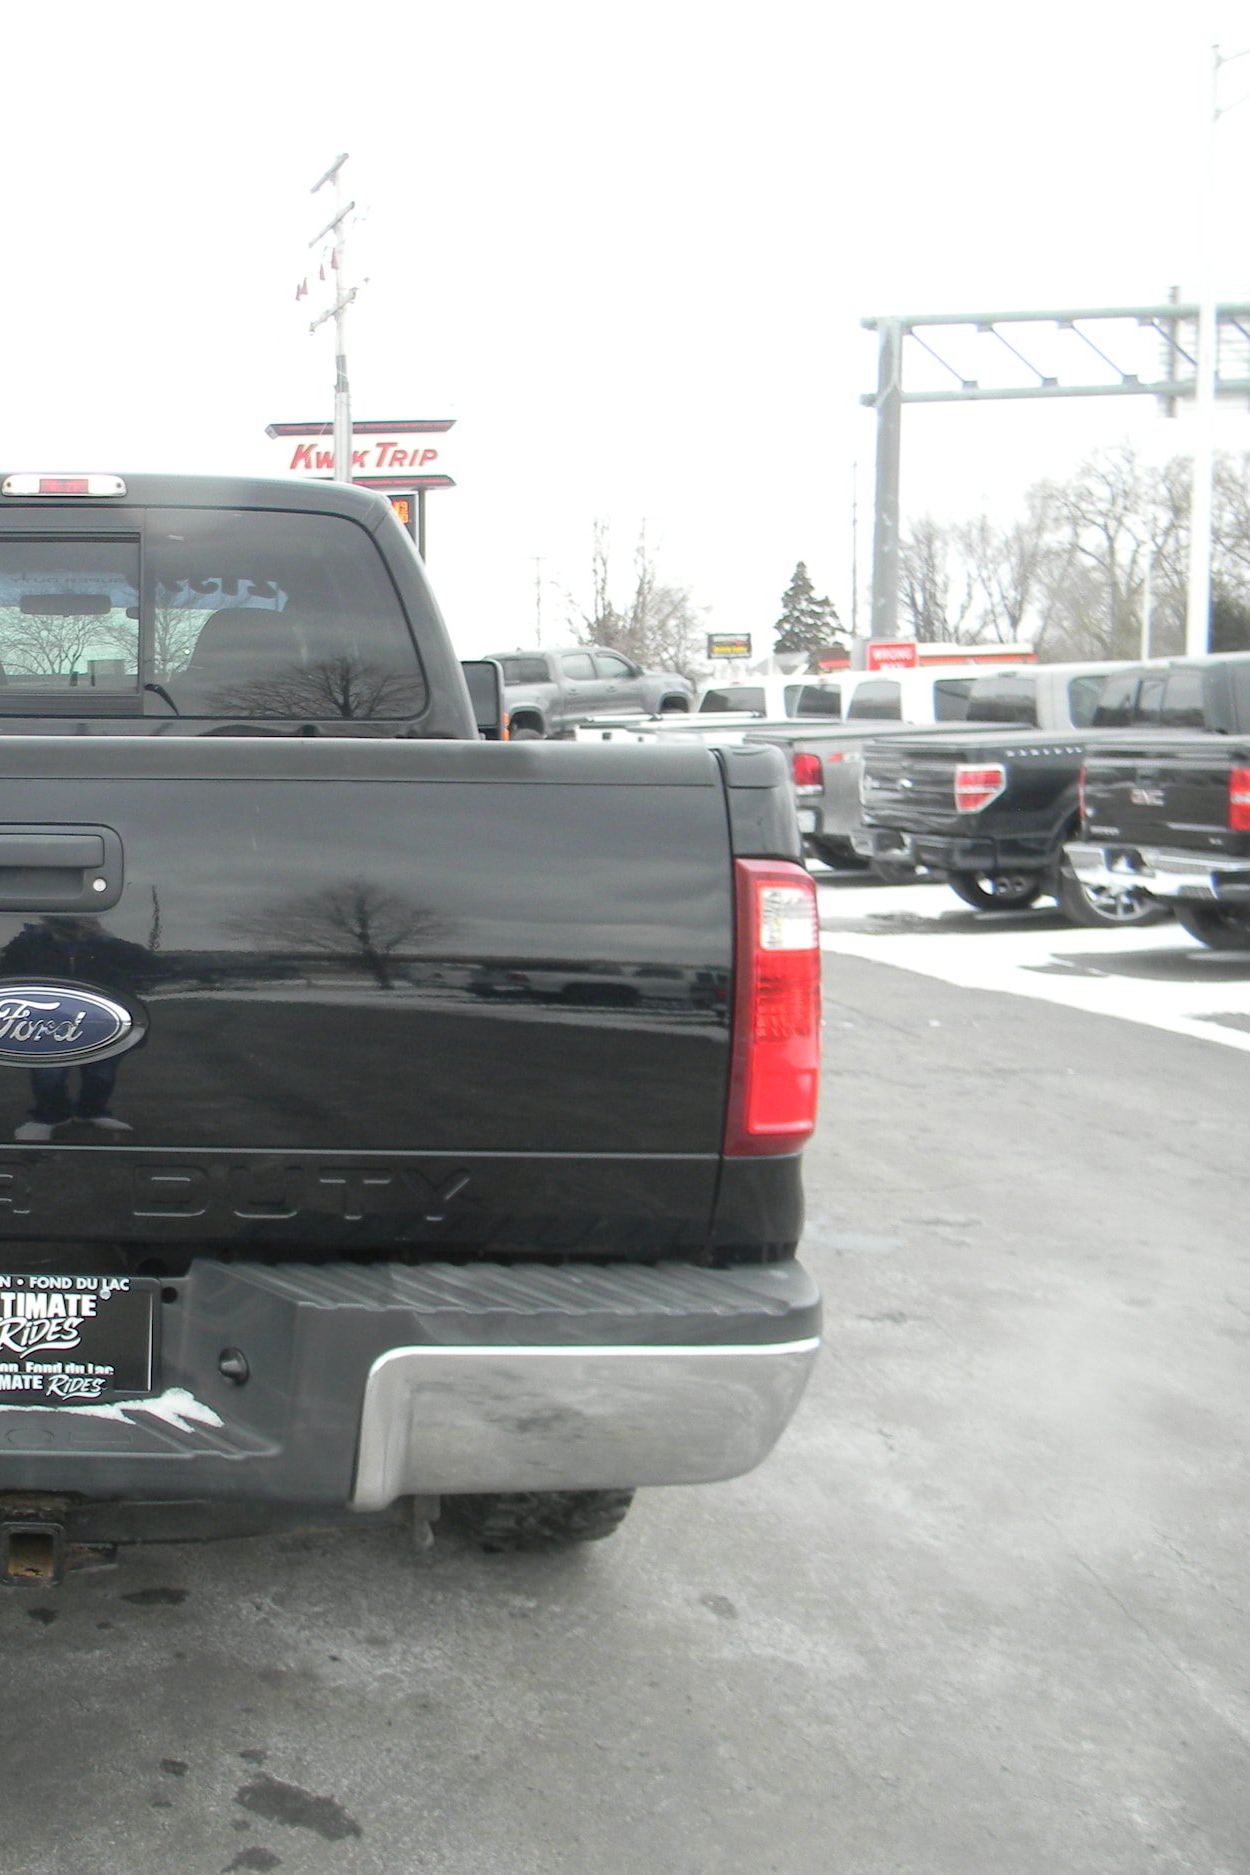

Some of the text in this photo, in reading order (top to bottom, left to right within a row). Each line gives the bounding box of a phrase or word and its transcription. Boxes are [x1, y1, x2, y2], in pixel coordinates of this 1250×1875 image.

[290, 442, 439, 470] KWK TRIP
[131, 1164, 478, 1221] DUTY
[29, 1276, 72, 1290] FOND
[76, 1278, 98, 1290] DU
[102, 1278, 130, 1291] LAC
